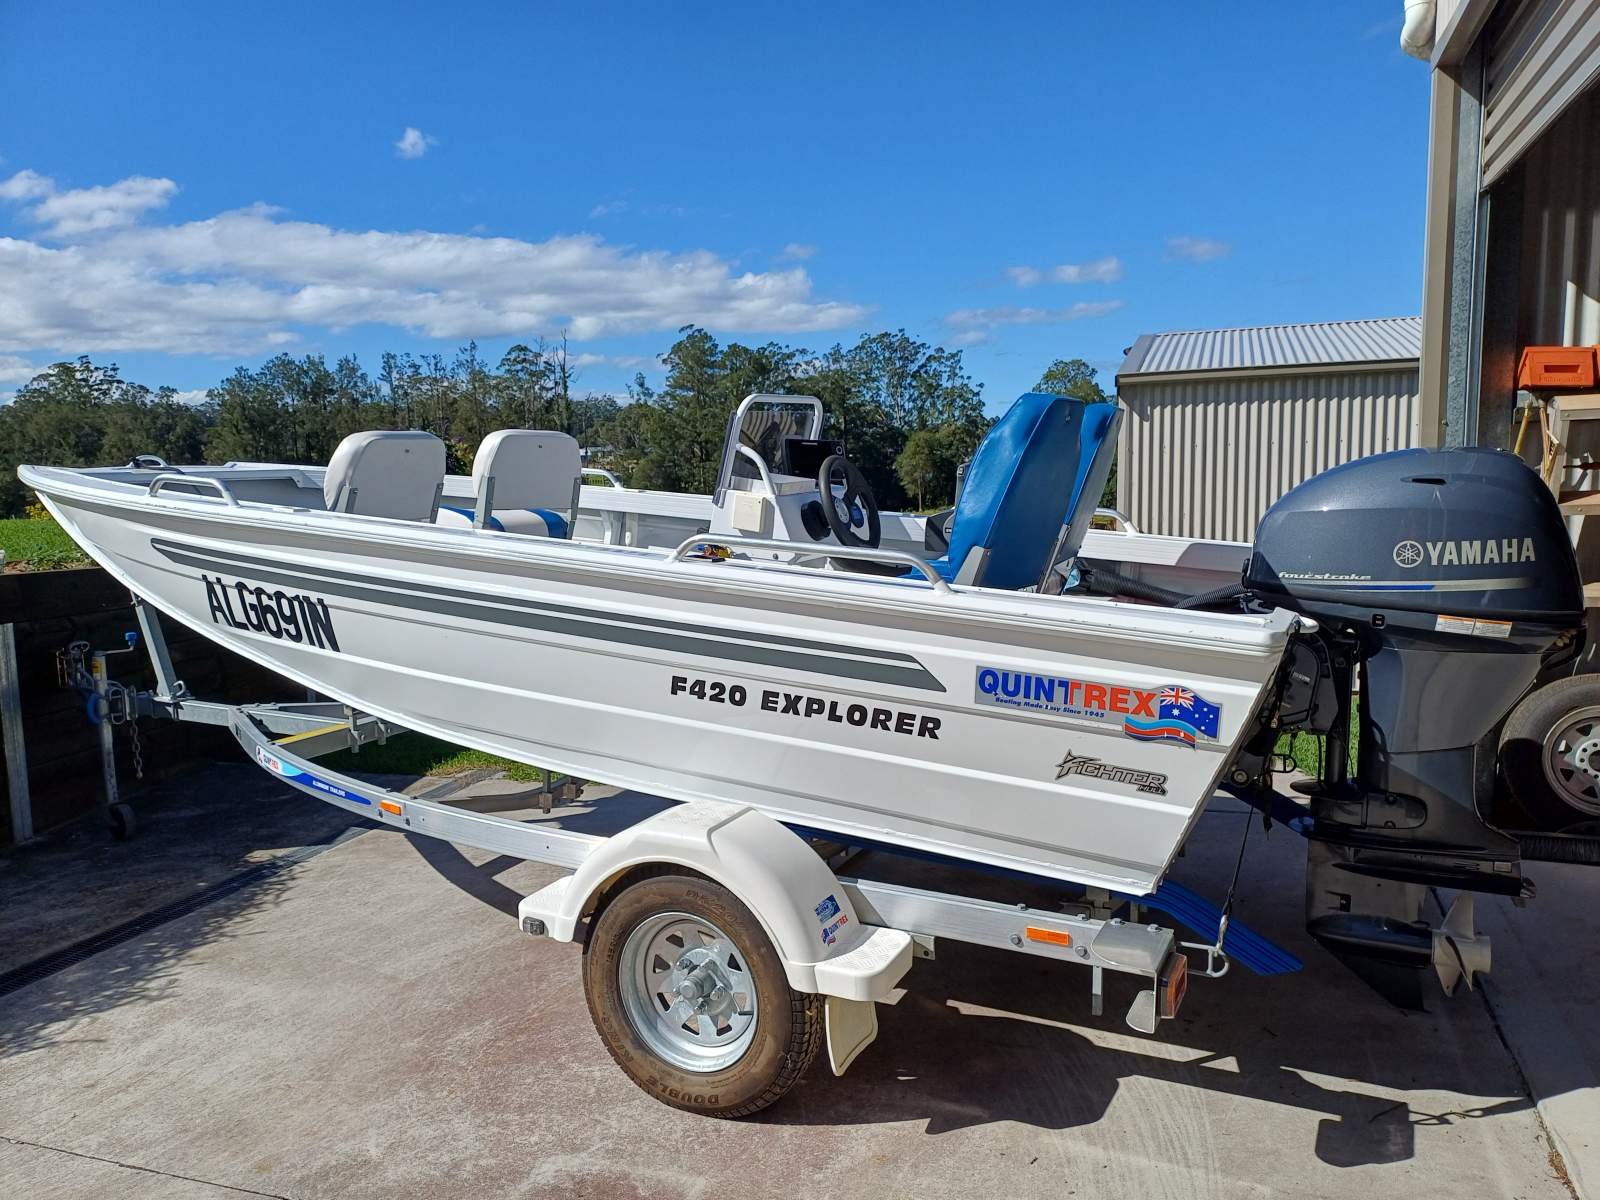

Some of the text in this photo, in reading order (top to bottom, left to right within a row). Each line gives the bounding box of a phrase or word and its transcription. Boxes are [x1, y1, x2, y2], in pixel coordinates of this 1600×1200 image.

[1426, 538, 1536, 566] YAMAHA
[201, 574, 341, 653] ALG691N
[670, 675, 942, 740] F420 EXPLORER
[978, 669, 1157, 718] QUINTREX
[1023, 701, 1043, 709] Made
[1063, 706, 1081, 715] Since
[1084, 710, 1105, 718] 1945
[647, 1075, 719, 1104] DOUBLE
